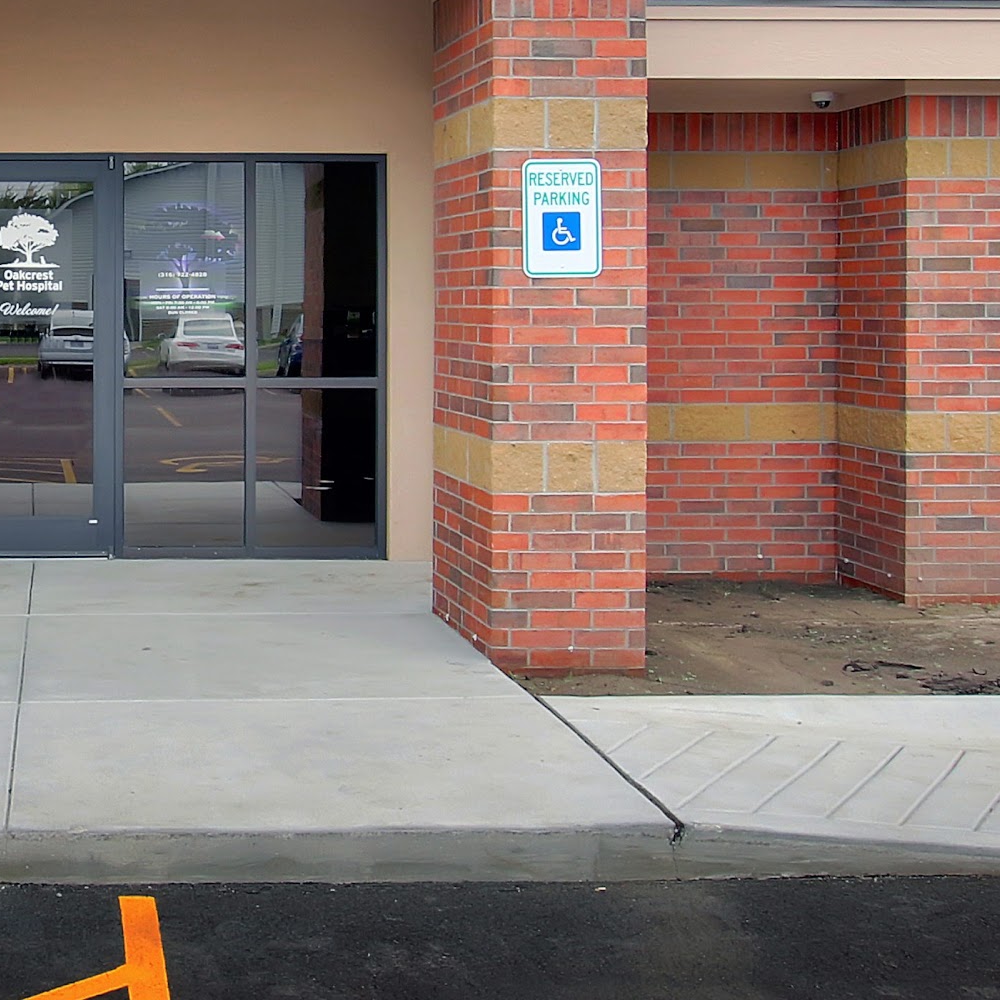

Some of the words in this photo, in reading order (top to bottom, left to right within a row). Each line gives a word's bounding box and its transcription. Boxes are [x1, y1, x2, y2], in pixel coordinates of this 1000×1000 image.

[529, 172, 594, 186] RESERVED
[533, 191, 590, 206] PARKING
[4, 269, 54, 280] Oakcrest
[16, 280, 63, 293] Hospital
[0, 302, 60, 316] Welcome!
